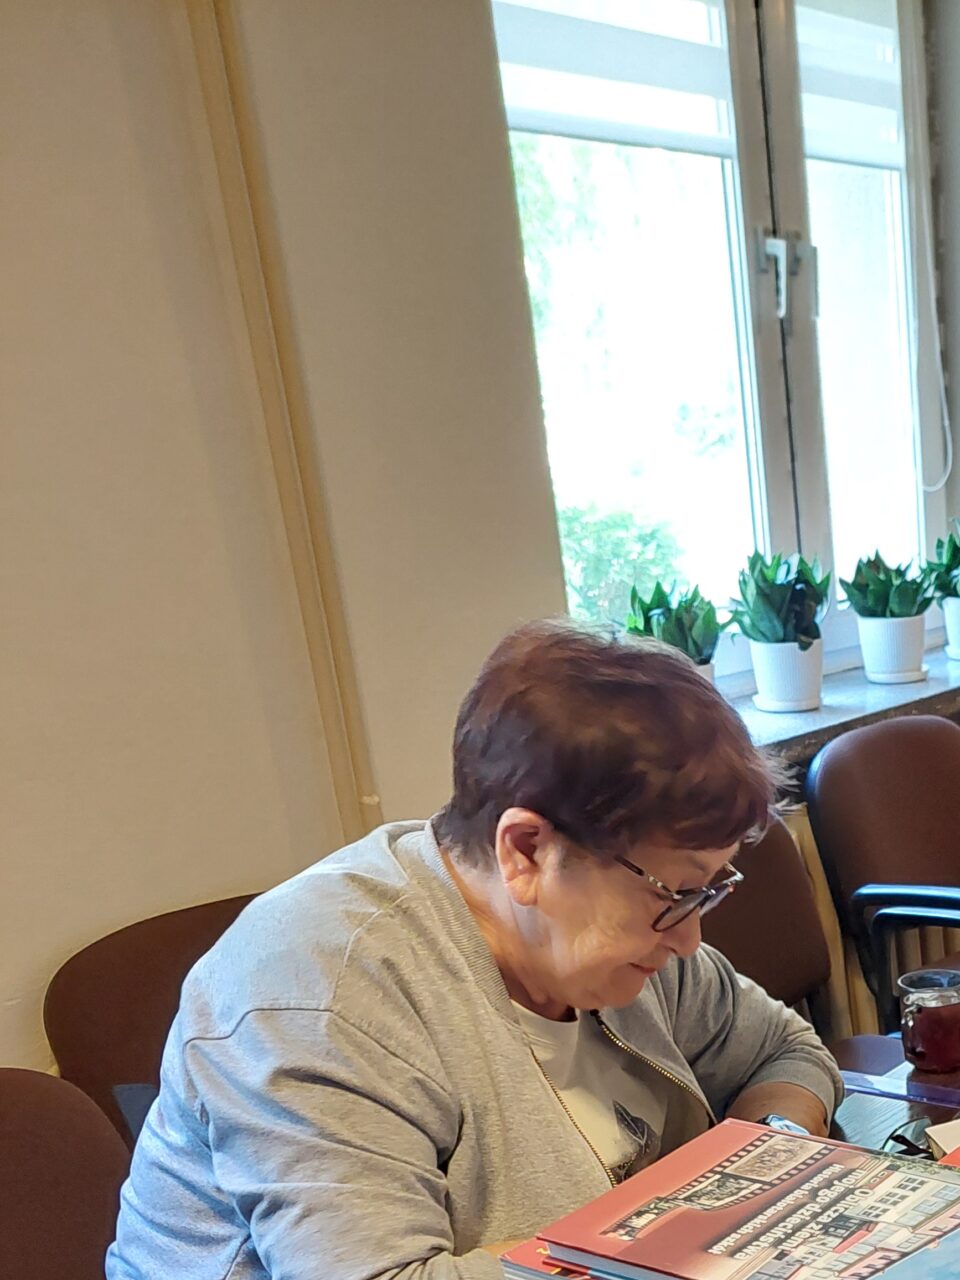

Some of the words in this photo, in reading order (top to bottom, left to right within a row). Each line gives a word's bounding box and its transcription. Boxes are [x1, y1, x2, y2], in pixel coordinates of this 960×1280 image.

[801, 1163, 845, 1191] Historia
[816, 1169, 865, 1203] mojego
[821, 1188, 873, 1225] Oblicza
[733, 1202, 820, 1259] dzieciństwa
[778, 1222, 822, 1251] ziemi
